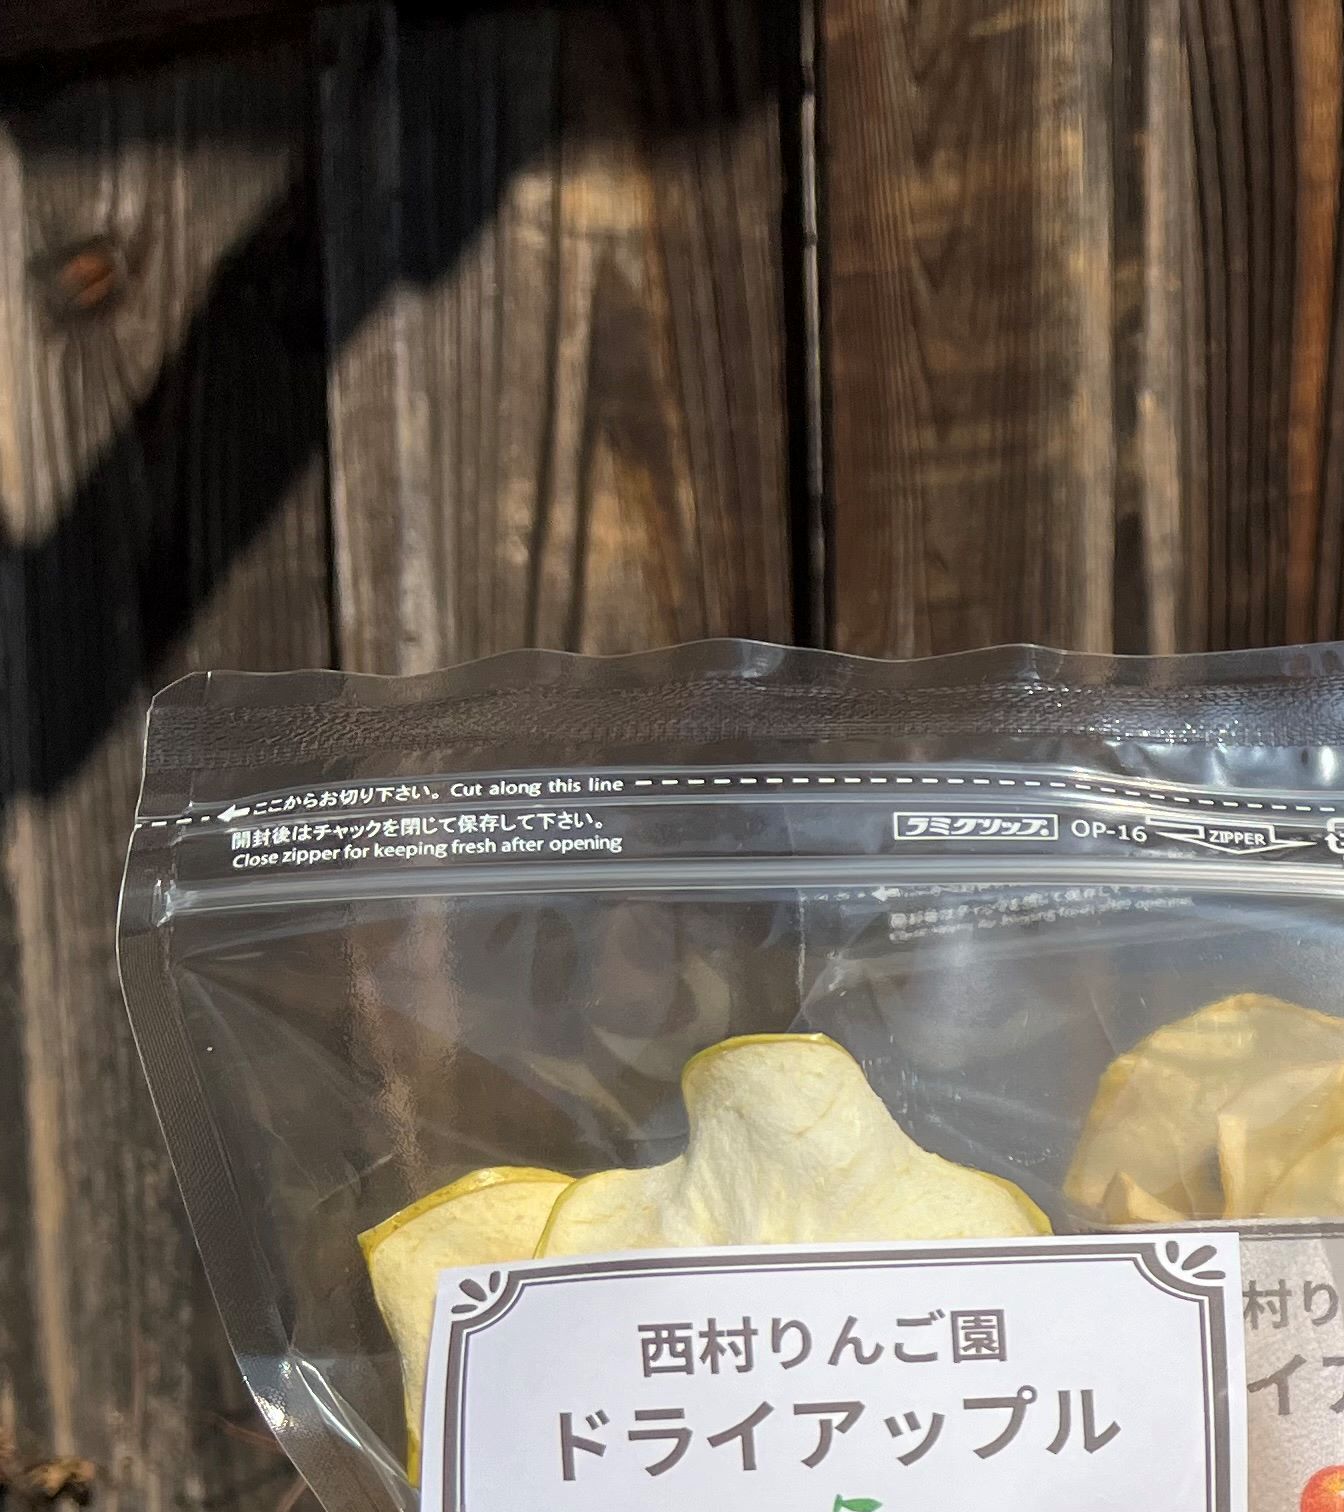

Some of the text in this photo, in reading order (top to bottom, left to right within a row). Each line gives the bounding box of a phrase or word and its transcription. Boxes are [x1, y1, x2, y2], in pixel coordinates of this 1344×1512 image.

[253, 777, 624, 815] ここからお切り下さい。 Cut along this line
[231, 811, 603, 850] 開封後はチャックを閉じて保存して下さい。
[1071, 819, 1148, 842] OP-16
[1209, 830, 1267, 846] ZIPPER
[232, 834, 623, 868] Close zipper for keeping fresh after opening
[637, 1309, 1007, 1378] 西村りんご園
[557, 1385, 1121, 1482] ドライアップル
